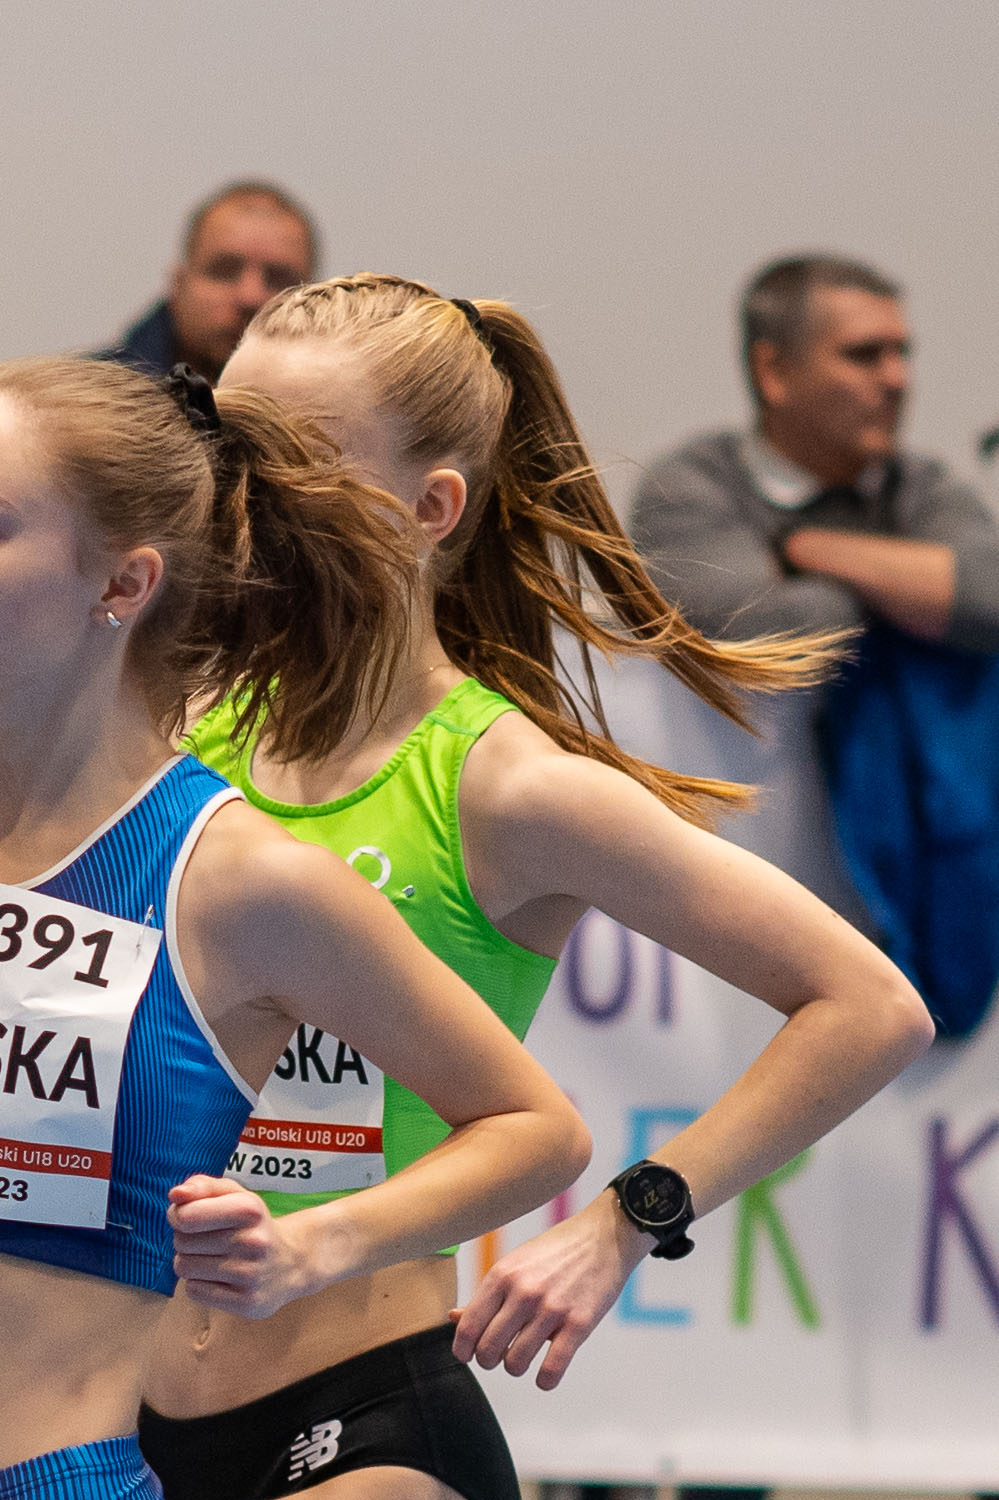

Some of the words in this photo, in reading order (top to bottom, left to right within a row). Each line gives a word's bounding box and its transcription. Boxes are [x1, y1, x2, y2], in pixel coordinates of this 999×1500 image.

[258, 1126, 302, 1143] Polski
[306, 1130, 332, 1145] U18
[335, 1133, 366, 1147] U20
[22, 1150, 53, 1167] U18
[57, 1154, 92, 1170] U20
[250, 1154, 313, 1180] 2023
